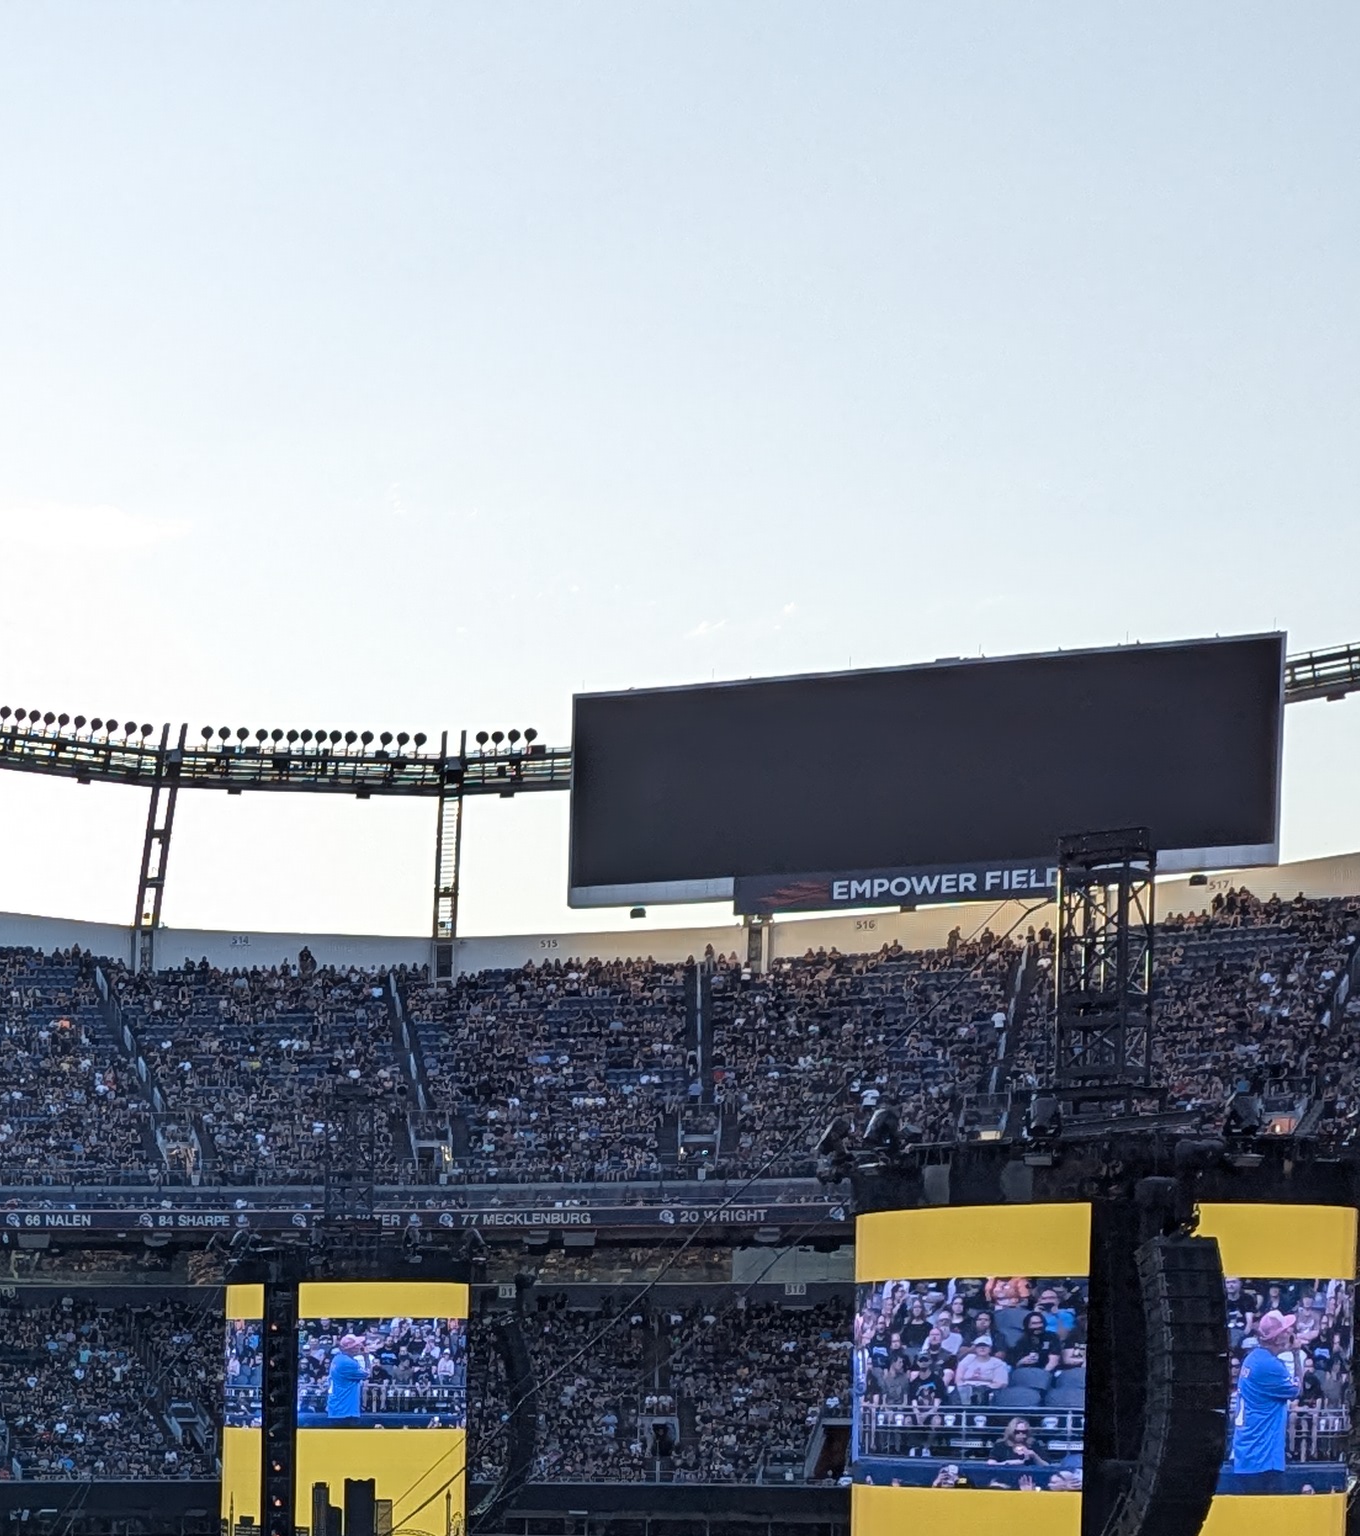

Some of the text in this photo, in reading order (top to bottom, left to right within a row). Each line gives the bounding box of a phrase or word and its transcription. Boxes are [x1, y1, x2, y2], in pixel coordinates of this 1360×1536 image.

[833, 867, 1059, 900] EMPOWER FIELD
[1209, 880, 1230, 890] 517
[856, 920, 875, 930] 516
[232, 935, 249, 944] 514
[540, 939, 559, 948] 515
[25, 1214, 91, 1226] 66 NALEN
[158, 1215, 230, 1227] 84 SHARPE
[461, 1213, 591, 1225] 77 MECKLENBURG
[680, 1209, 768, 1223] 20 WRIGHT
